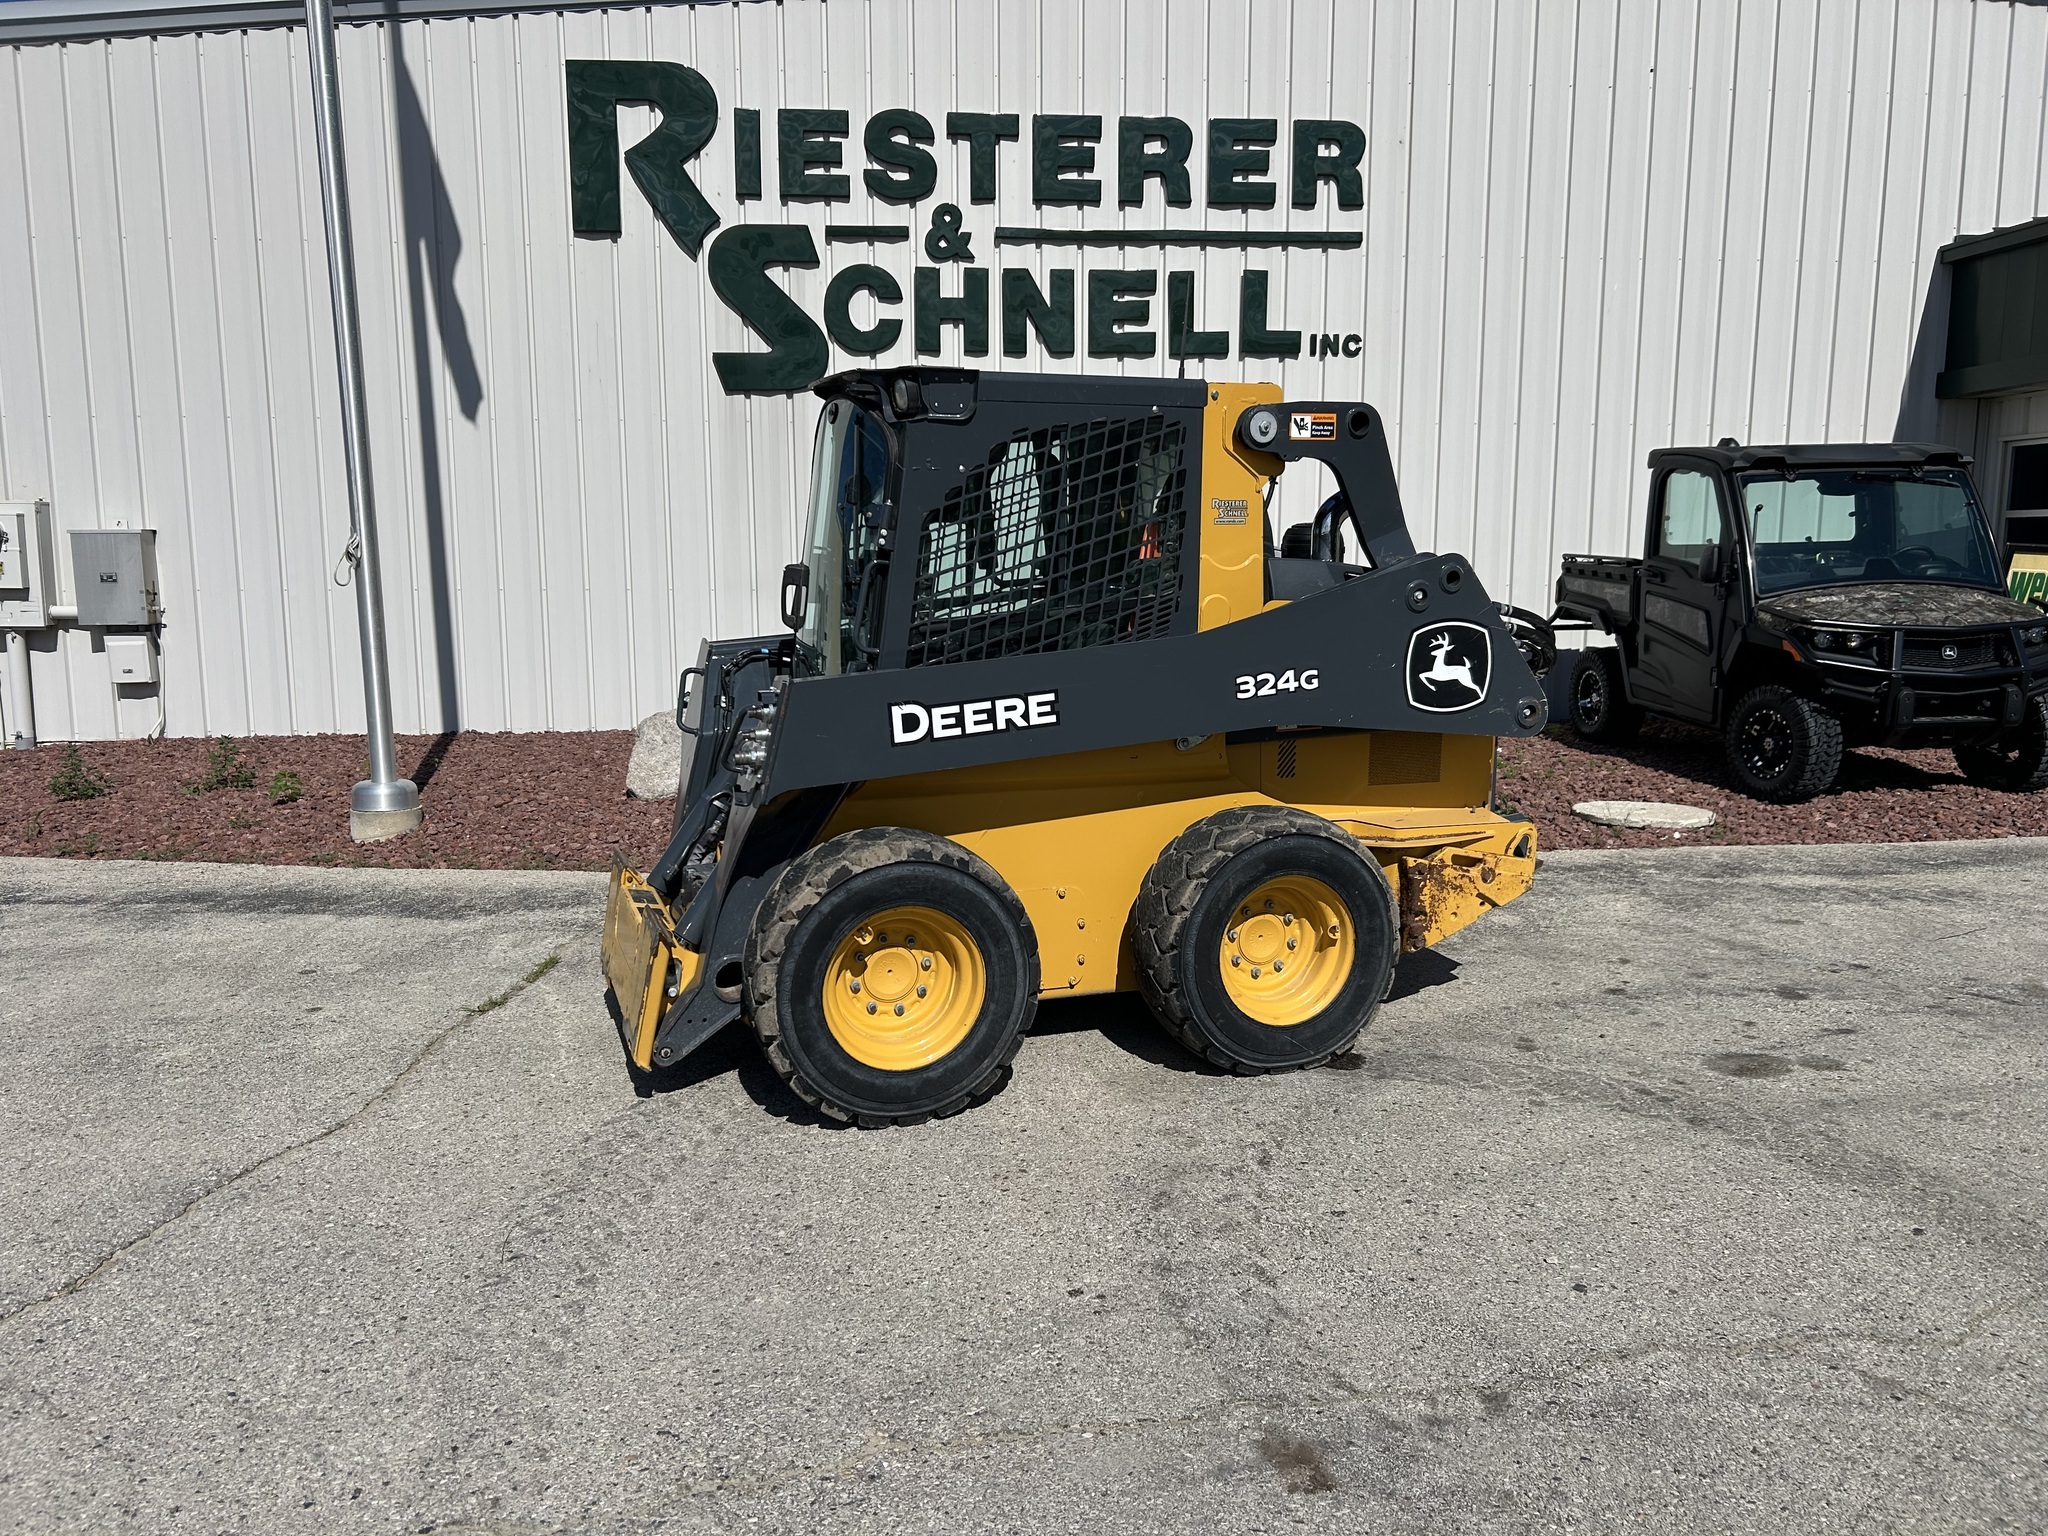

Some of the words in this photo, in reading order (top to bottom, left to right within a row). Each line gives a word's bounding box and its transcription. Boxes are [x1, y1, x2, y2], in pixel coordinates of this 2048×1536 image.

[565, 59, 1366, 262] RIESTERER
[924, 203, 976, 263] &
[707, 224, 1303, 395] SCHNELL
[1308, 333, 1363, 360] INC
[1212, 498, 1248, 509] RIESTERER
[1218, 509, 1248, 518] SCHNELL
[1236, 669, 1320, 699] 324G
[891, 692, 1057, 744] DEERE
